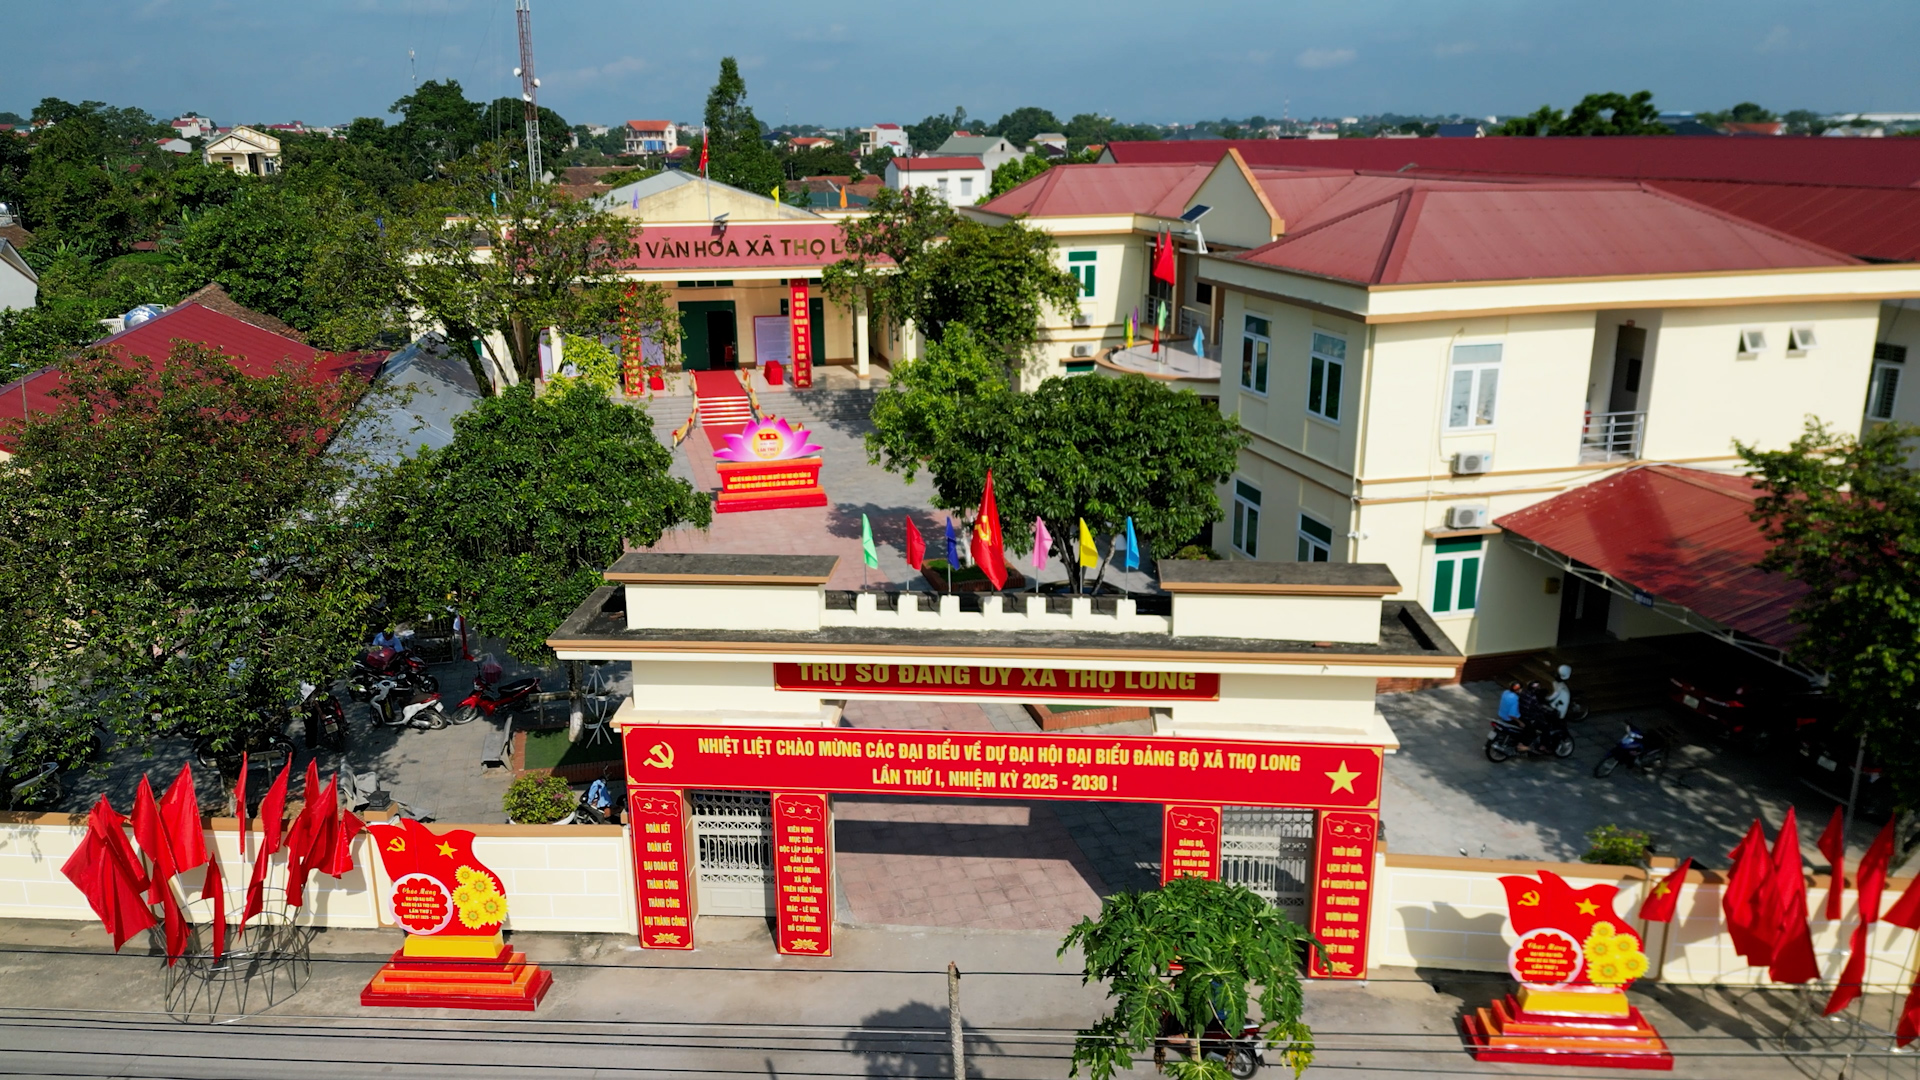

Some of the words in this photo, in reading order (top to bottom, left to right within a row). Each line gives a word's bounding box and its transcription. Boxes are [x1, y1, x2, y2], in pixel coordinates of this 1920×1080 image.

[646, 237, 690, 259] VĂN
[746, 235, 776, 257] XÃ
[780, 238, 826, 259] THỌ
[797, 663, 847, 686] TRỤ
[1065, 669, 1115, 692] THỌ
[1125, 671, 1196, 690] LONG
[698, 735, 739, 757] NHIỆT
[743, 736, 772, 758] LIỆT
[776, 737, 814, 756] CHÀO
[818, 740, 862, 757] MỪNG
[865, 740, 895, 758] CÁC
[898, 743, 923, 762] ĐẠI
[927, 738, 960, 760] BIỂU
[964, 740, 982, 761] VỀ
[985, 744, 1007, 765] DỰ
[1009, 746, 1034, 766] ĐẠI
[1038, 744, 1062, 766] HỘI
[1066, 747, 1091, 767] ĐẠI
[1095, 742, 1129, 765] BIỂU
[1133, 744, 1175, 766] ĐẢNG
[1178, 748, 1199, 771] BỘ
[1203, 749, 1224, 768] XÃ
[1228, 752, 1257, 773] THỌ
[1260, 754, 1301, 771] LONG
[872, 763, 900, 785] LẦN
[904, 767, 933, 786] THỨ
[935, 770, 945, 788] I,
[949, 768, 996, 790] NHIỆM
[1000, 769, 1019, 788] KỲ
[1022, 772, 1058, 790] 2025
[1072, 774, 1108, 791] 2030
